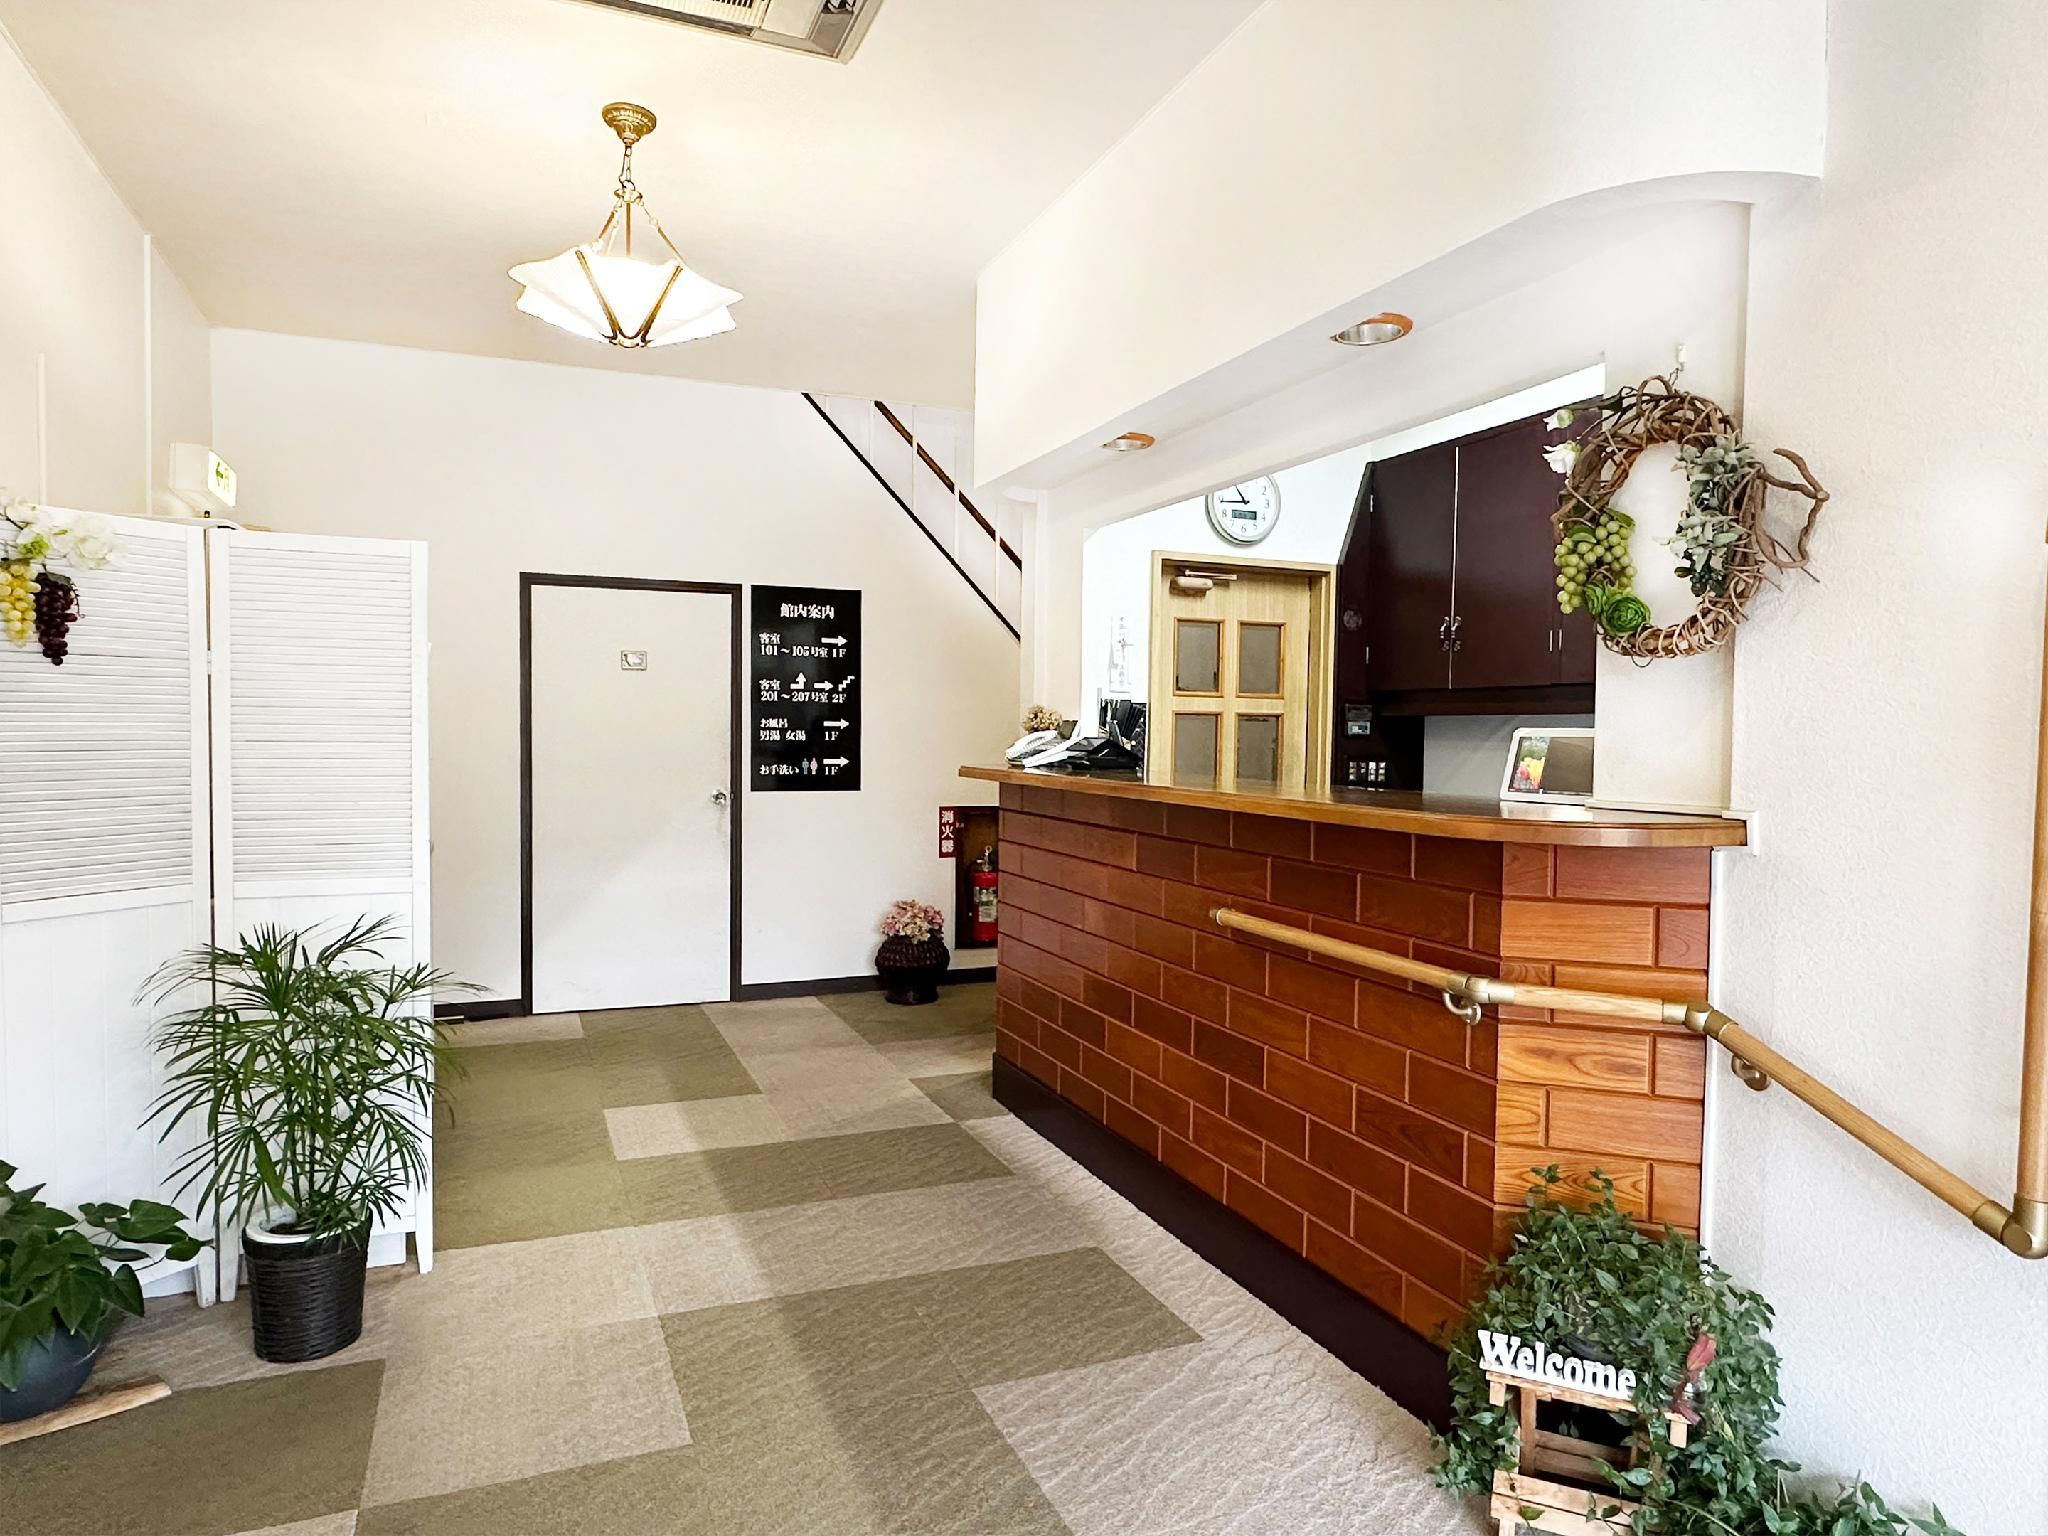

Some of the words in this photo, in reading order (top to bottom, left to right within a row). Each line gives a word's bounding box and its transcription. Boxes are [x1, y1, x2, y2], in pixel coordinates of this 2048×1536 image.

[780, 602, 835, 619] 館内案内
[832, 648, 847, 658] 1F
[832, 693, 847, 703] 2F
[824, 731, 839, 741] 1F
[760, 764, 800, 775] お手洗い
[824, 766, 839, 775] 1F
[1477, 1329, 1637, 1400] Welcome
